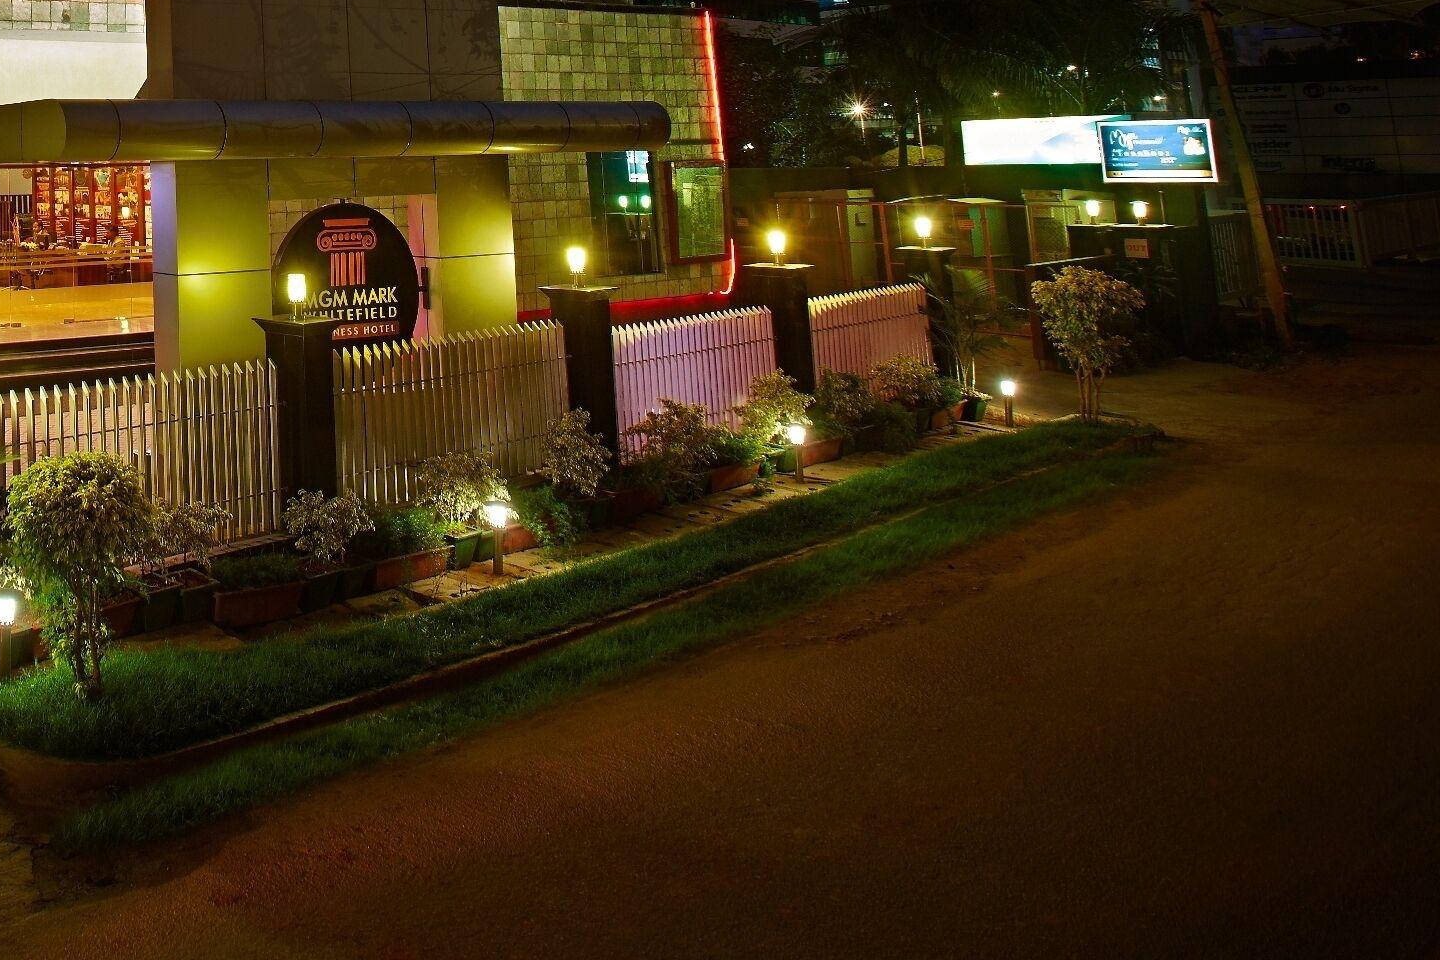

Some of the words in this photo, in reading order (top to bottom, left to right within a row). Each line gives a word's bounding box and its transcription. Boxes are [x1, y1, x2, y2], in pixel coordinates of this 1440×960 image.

[1127, 244, 1146, 252] OUT
[303, 289, 349, 309] MGM
[352, 286, 398, 306] MARK
[363, 324, 396, 335] HOTEL
